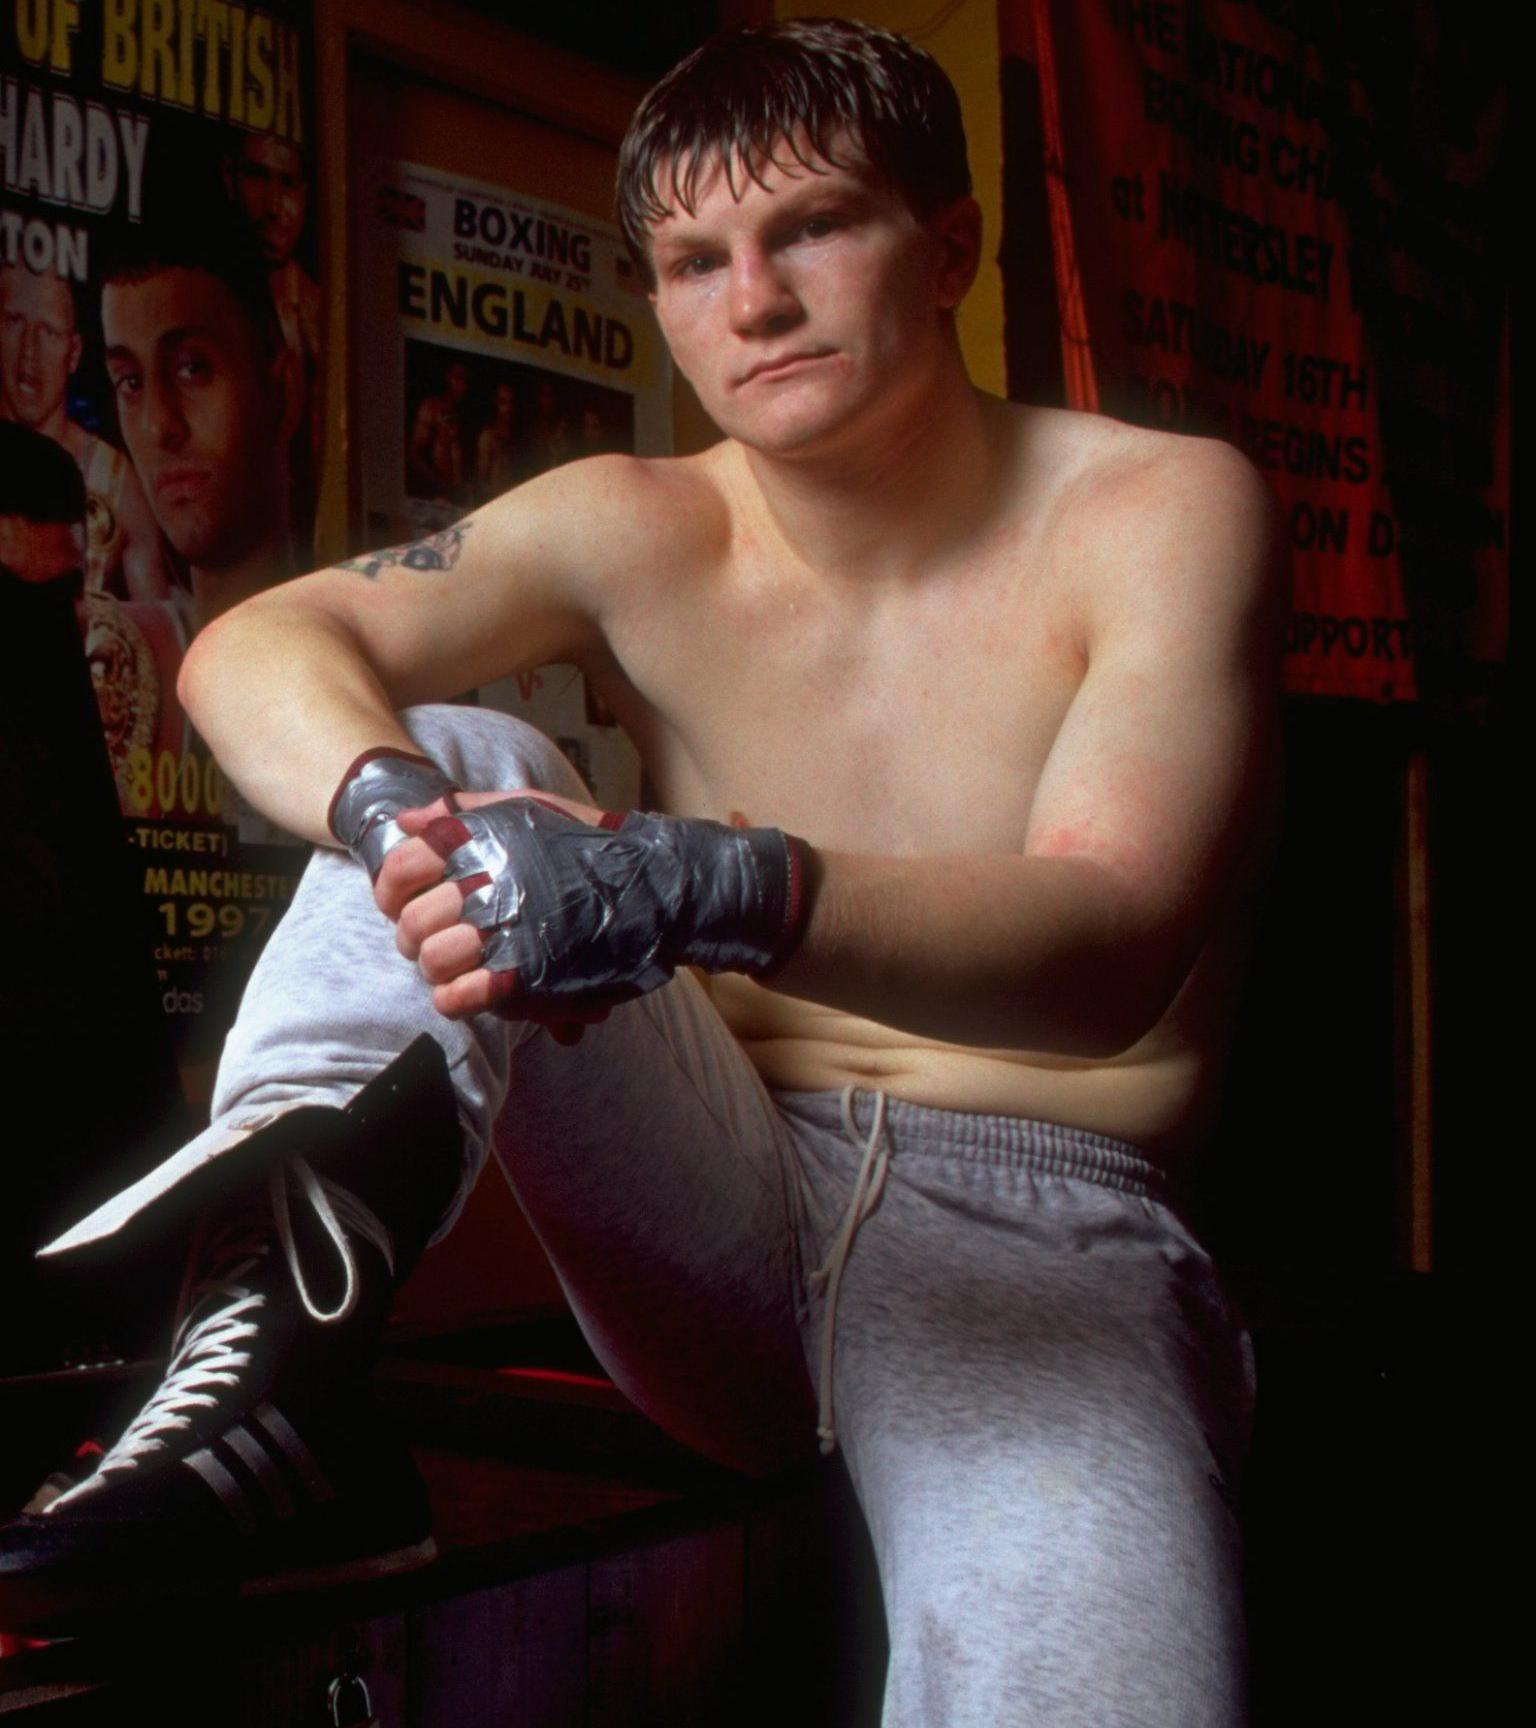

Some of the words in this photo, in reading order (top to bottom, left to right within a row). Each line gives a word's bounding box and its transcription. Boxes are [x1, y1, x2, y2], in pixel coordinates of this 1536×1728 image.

[101, 0, 305, 144] BRITISH
[453, 199, 592, 275] BOXING
[453, 242, 524, 274] SUNDAY
[398, 260, 634, 371] ENGLAND
[143, 865, 292, 898] MANCHESTE
[158, 901, 271, 938] 1997
[162, 985, 205, 1014] das
